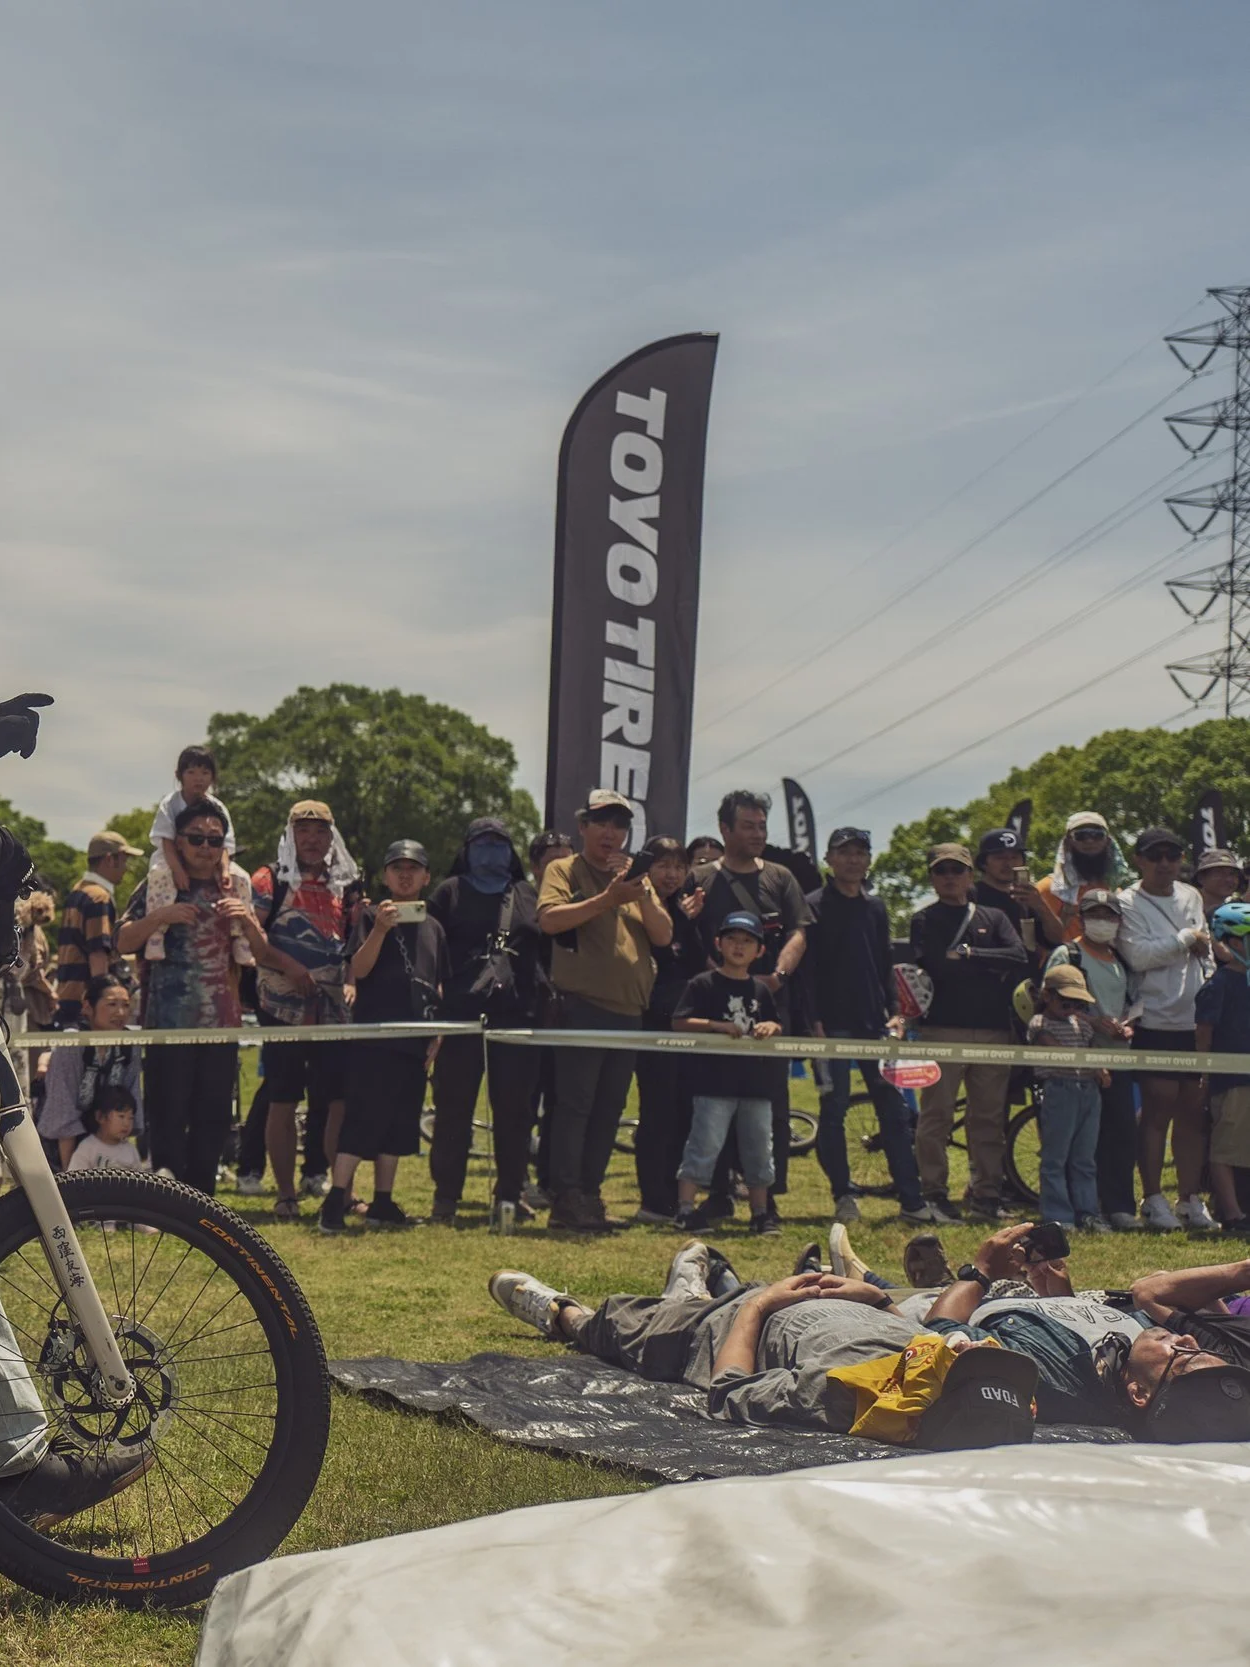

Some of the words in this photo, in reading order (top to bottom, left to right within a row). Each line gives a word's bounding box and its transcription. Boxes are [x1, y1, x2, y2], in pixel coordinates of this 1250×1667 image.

[606, 387, 667, 606] TOYO
[198, 1218, 299, 1341] CONTINENTAL
[66, 1561, 211, 1591] CONTINENTAL
